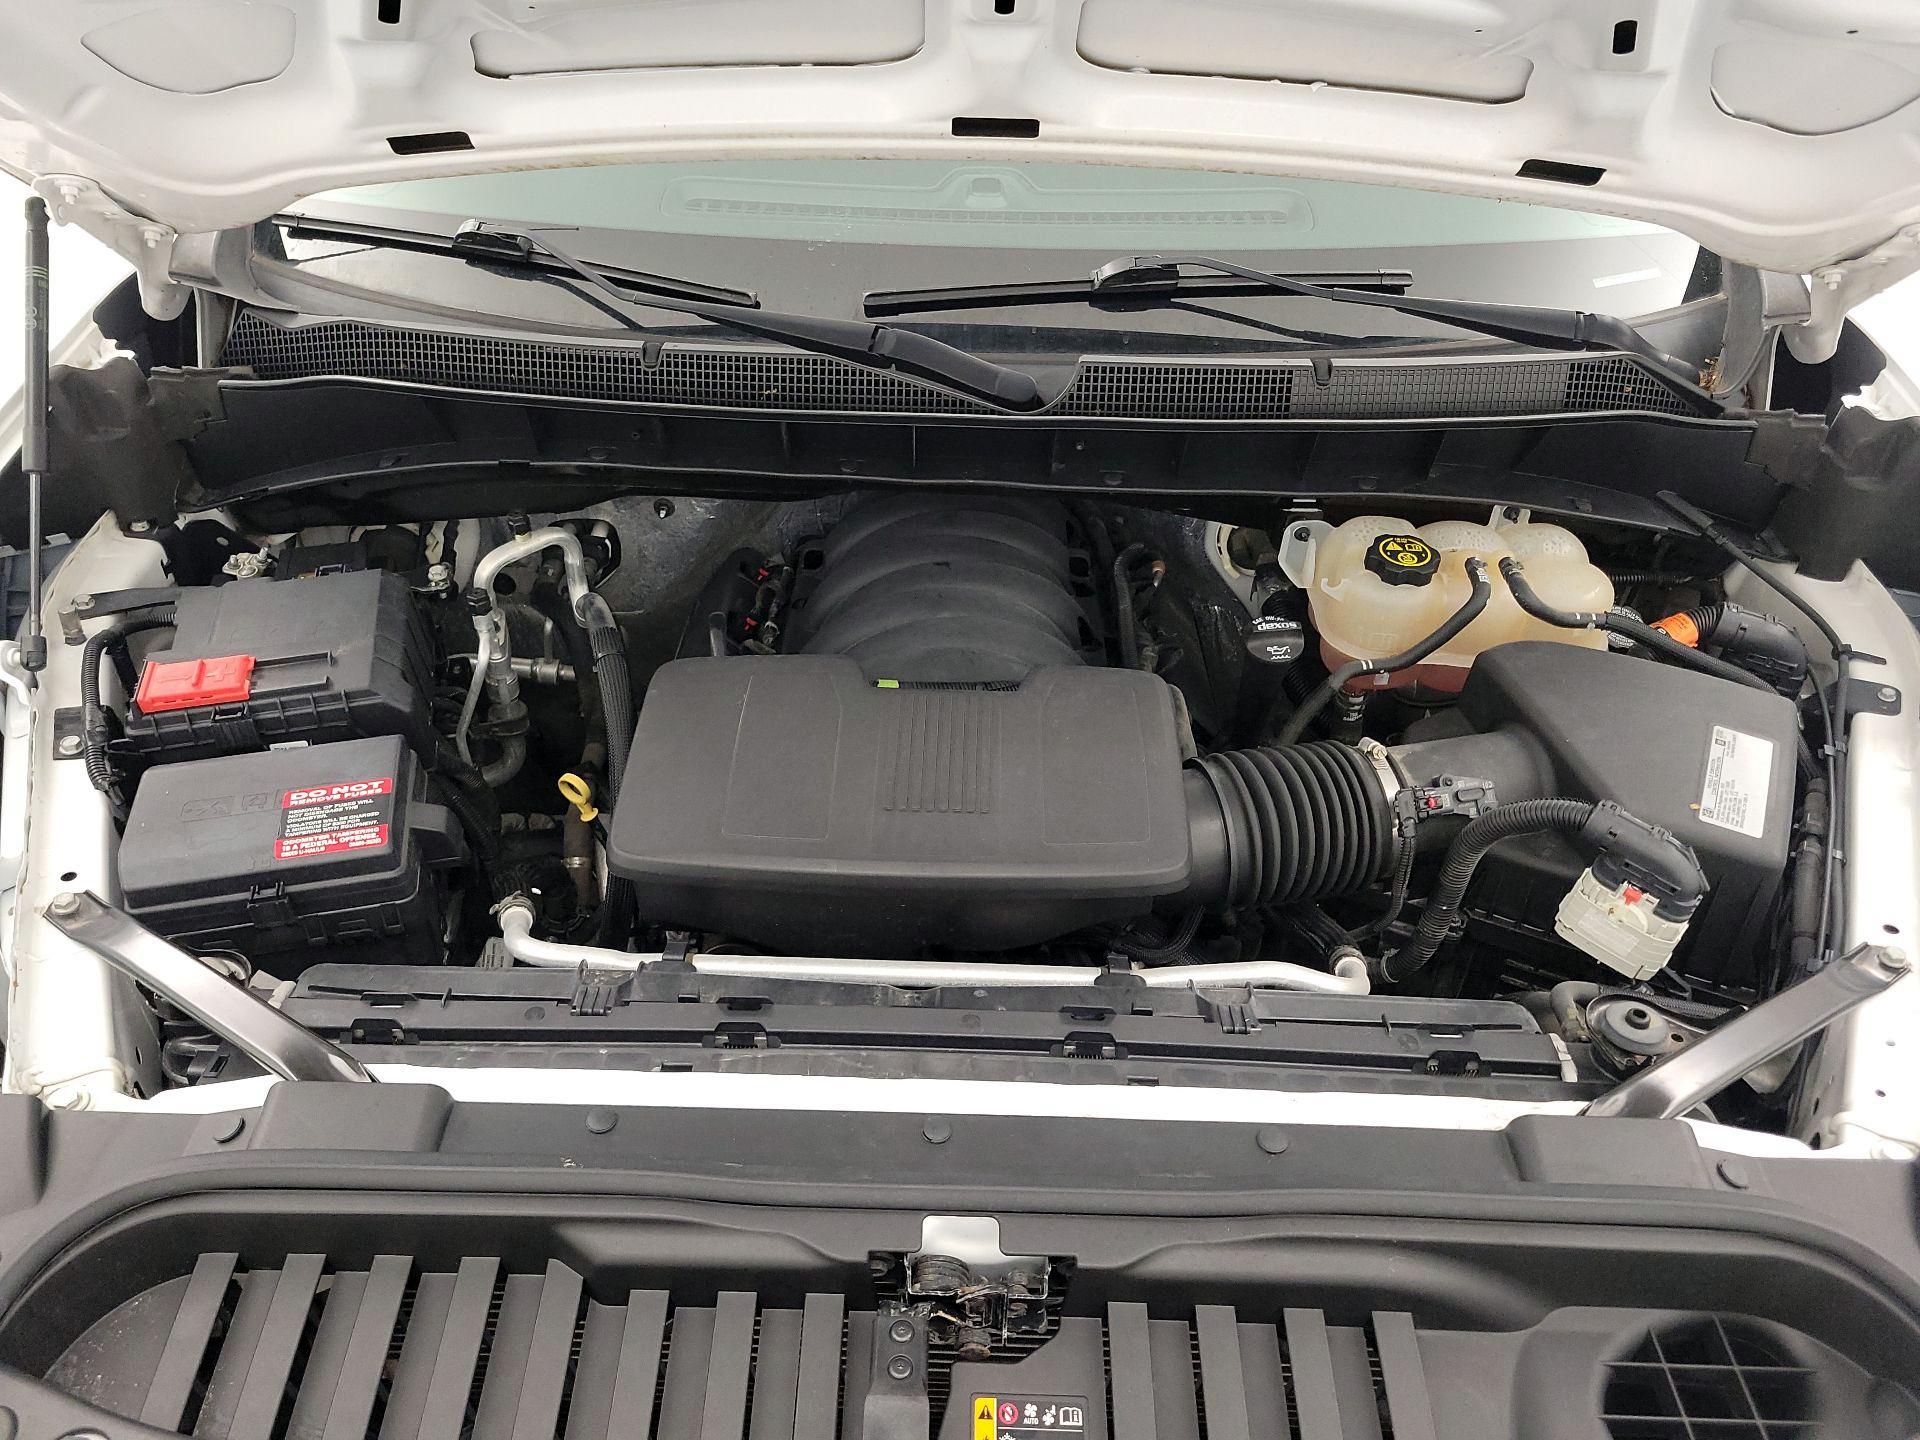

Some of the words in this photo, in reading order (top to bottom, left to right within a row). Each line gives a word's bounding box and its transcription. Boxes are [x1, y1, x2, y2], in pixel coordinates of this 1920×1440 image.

[1257, 621, 1298, 631] dexos
[290, 789, 327, 801] DO
[332, 780, 385, 794] NOT
[290, 794, 341, 806] REMOVE
[344, 787, 383, 798] FUSES
[282, 834, 331, 846] ODOMETER
[332, 826, 380, 838] TAMPERING
[300, 839, 338, 849] FEDERAL
